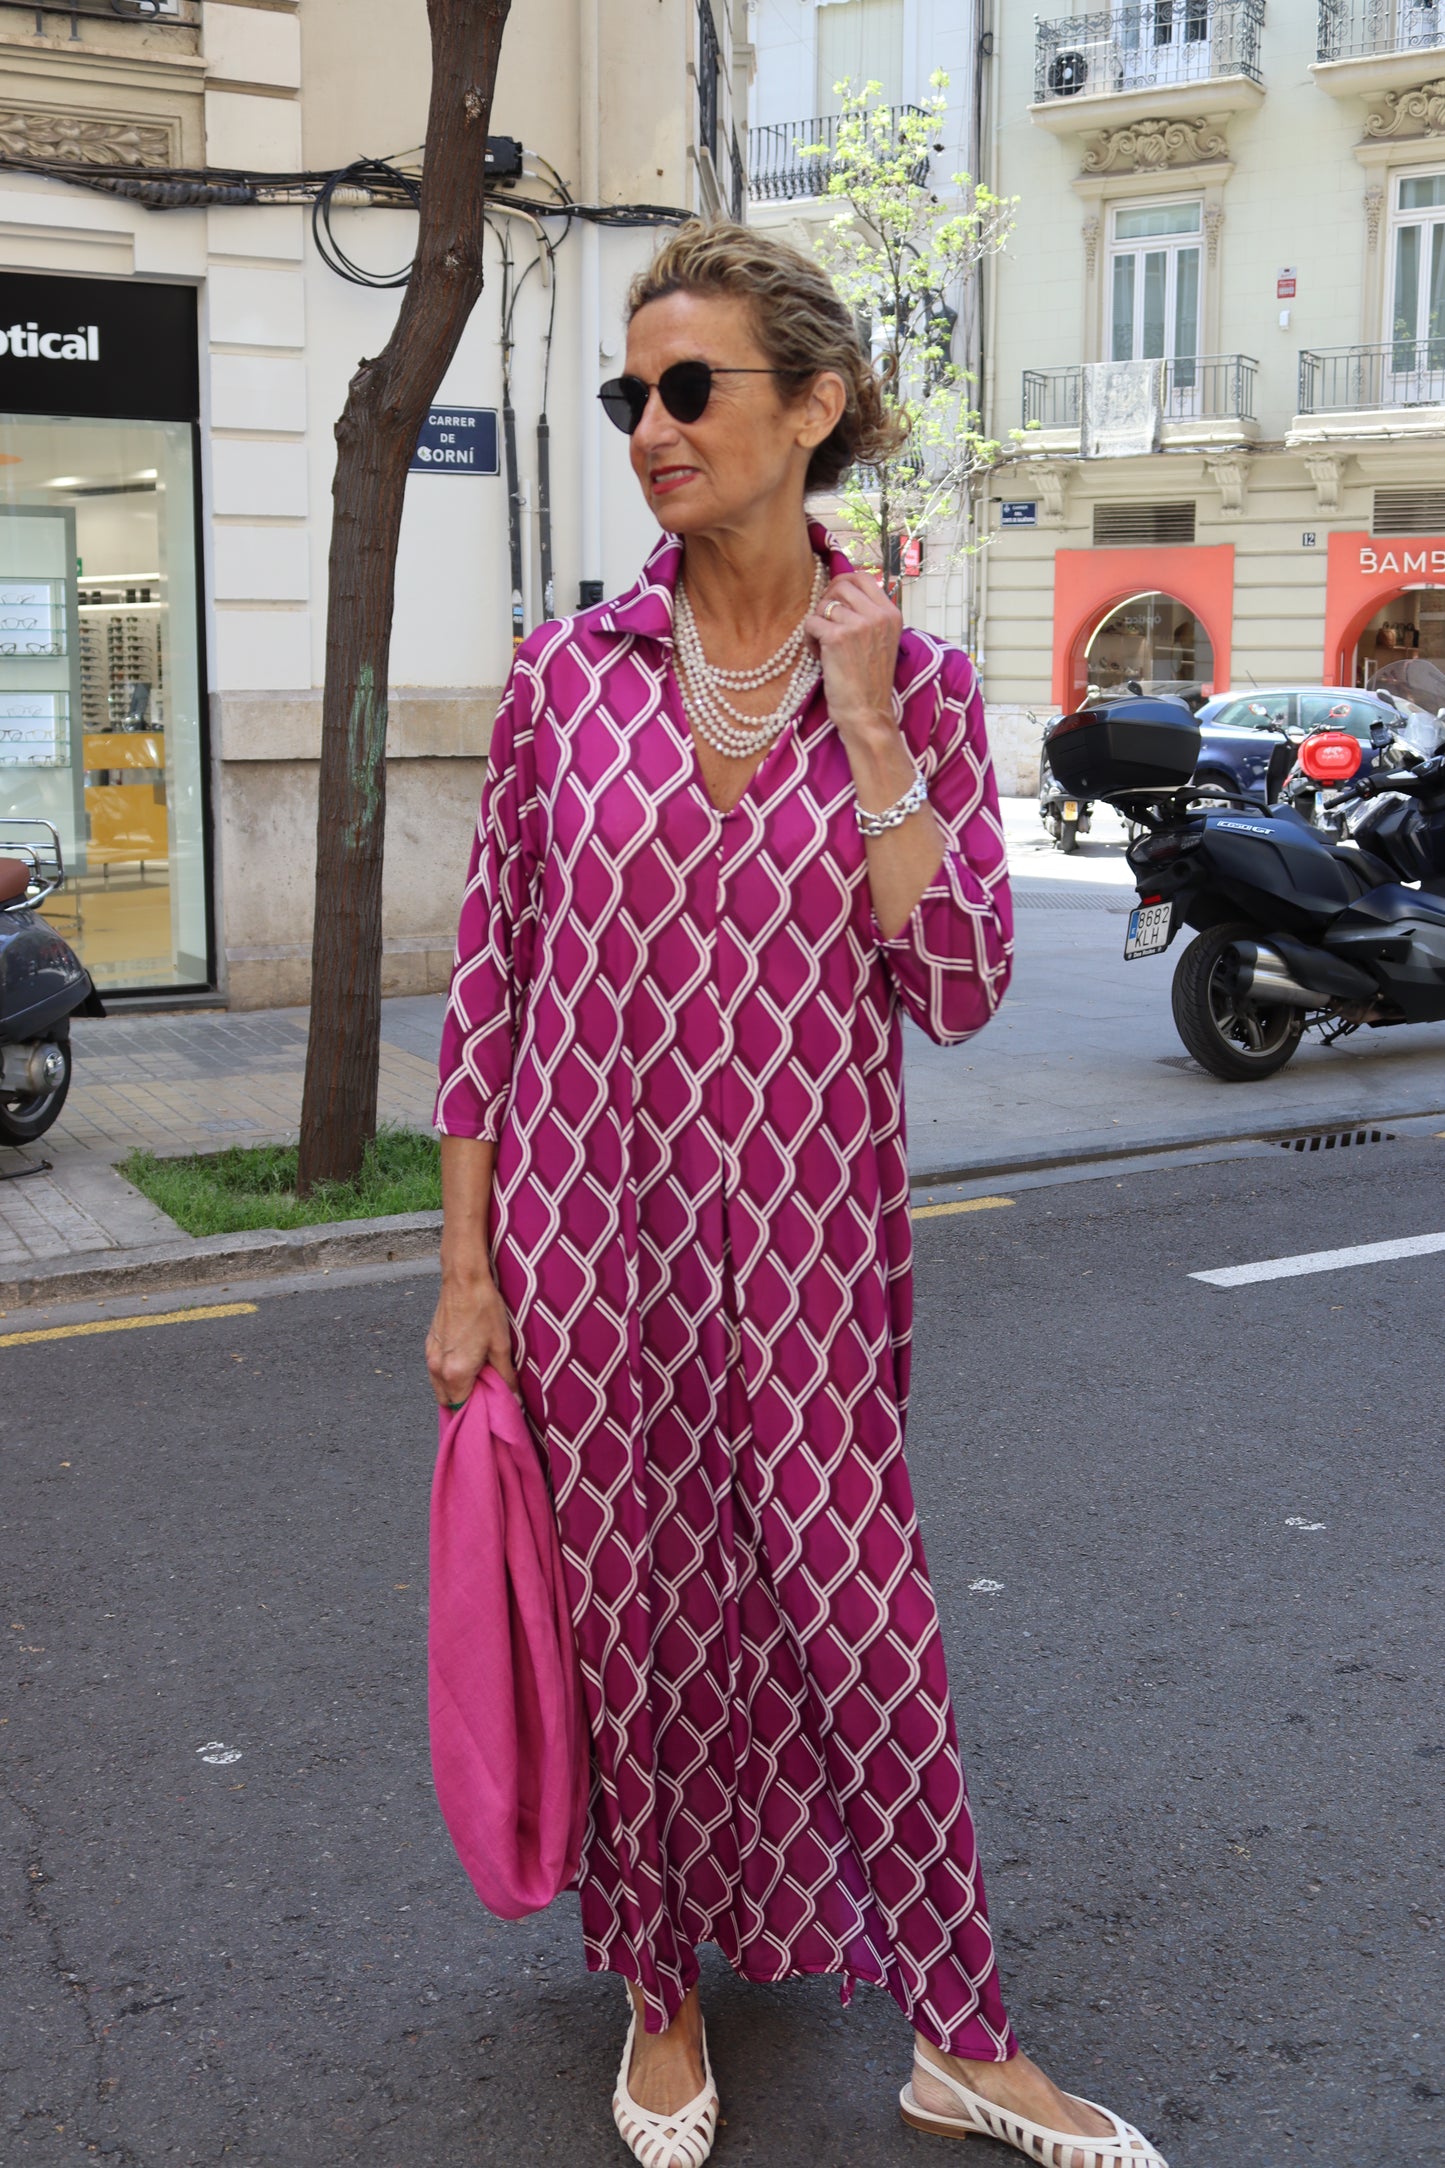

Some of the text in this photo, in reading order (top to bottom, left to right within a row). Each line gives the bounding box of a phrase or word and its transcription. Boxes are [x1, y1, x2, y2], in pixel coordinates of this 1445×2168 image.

[428, 415, 475, 427] CARRER
[440, 433, 455, 443] DE
[1304, 534, 1315, 545] 12
[1138, 906, 1169, 928] 8682
[1135, 927, 1159, 948] KLH
